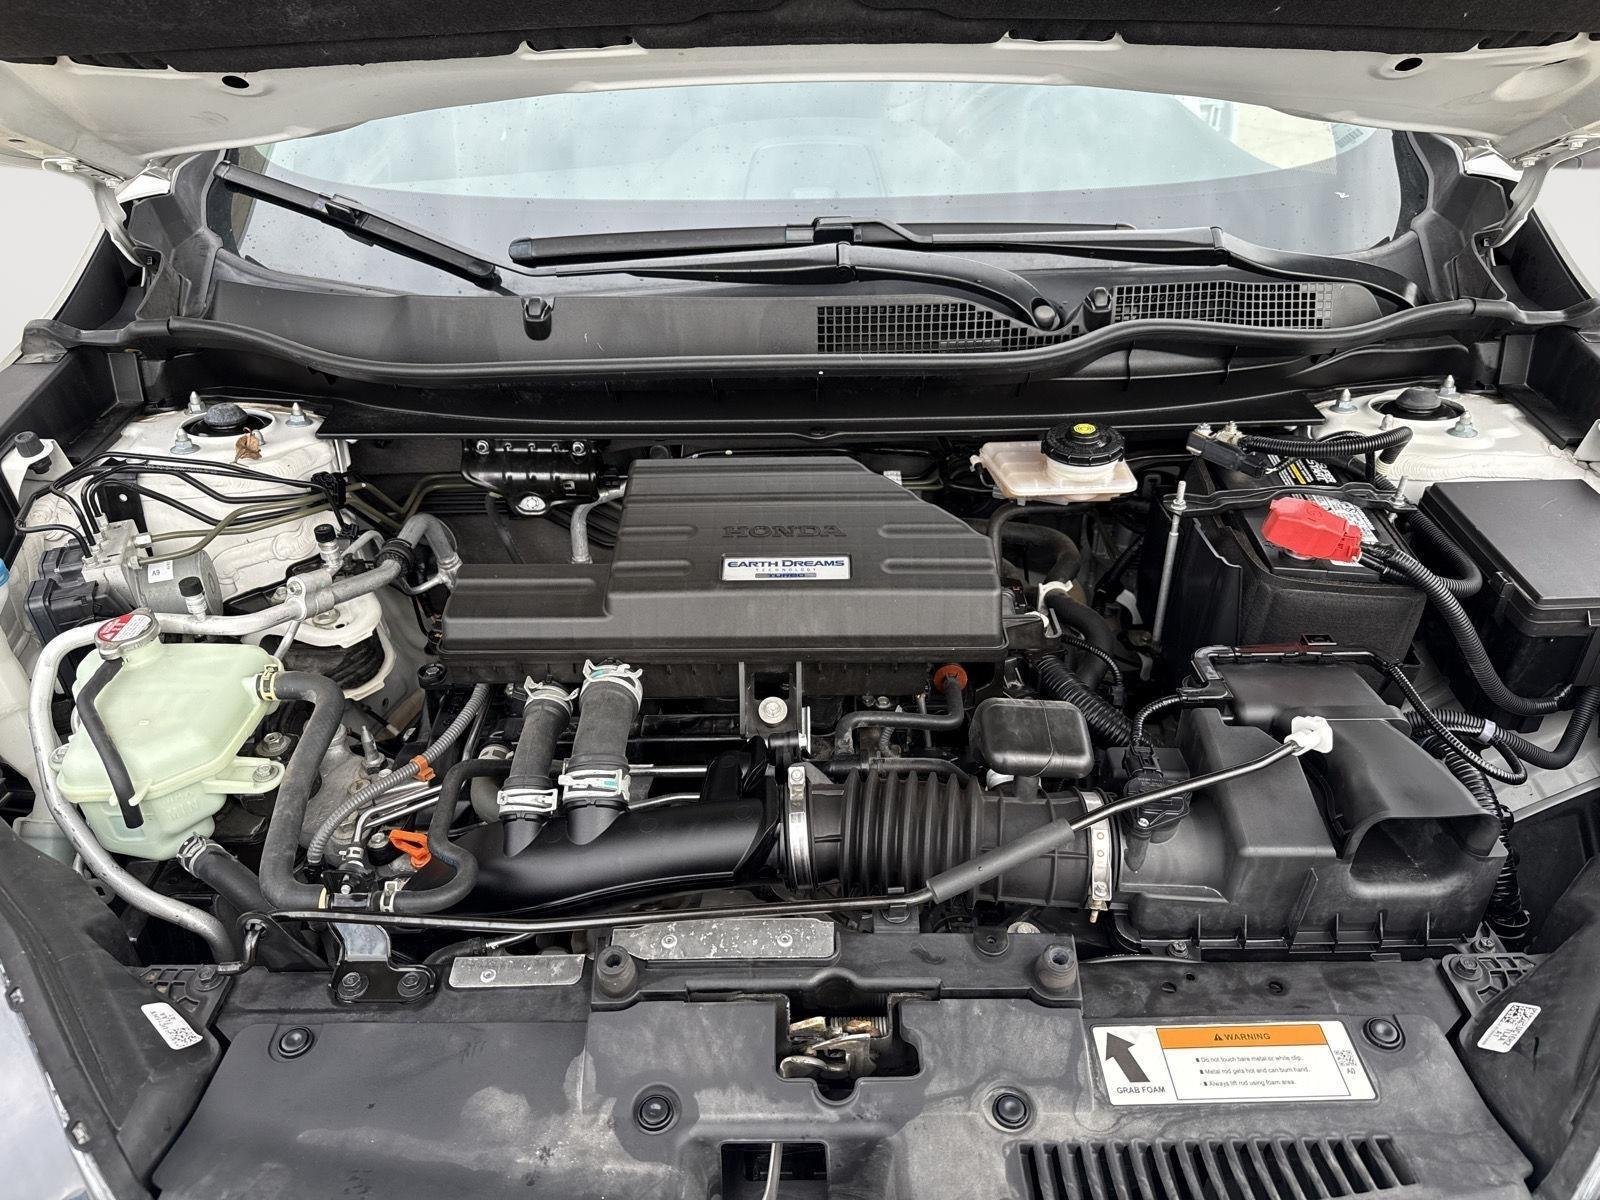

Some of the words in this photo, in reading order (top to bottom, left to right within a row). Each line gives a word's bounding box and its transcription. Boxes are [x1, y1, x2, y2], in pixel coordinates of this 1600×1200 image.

[722, 525, 848, 538] HONDA
[728, 560, 779, 568] EARTH
[782, 559, 845, 568] DREAMS
[1223, 1032, 1271, 1041] WARNING
[1116, 1086, 1140, 1094] GRAB
[1141, 1085, 1166, 1094] FOAM
